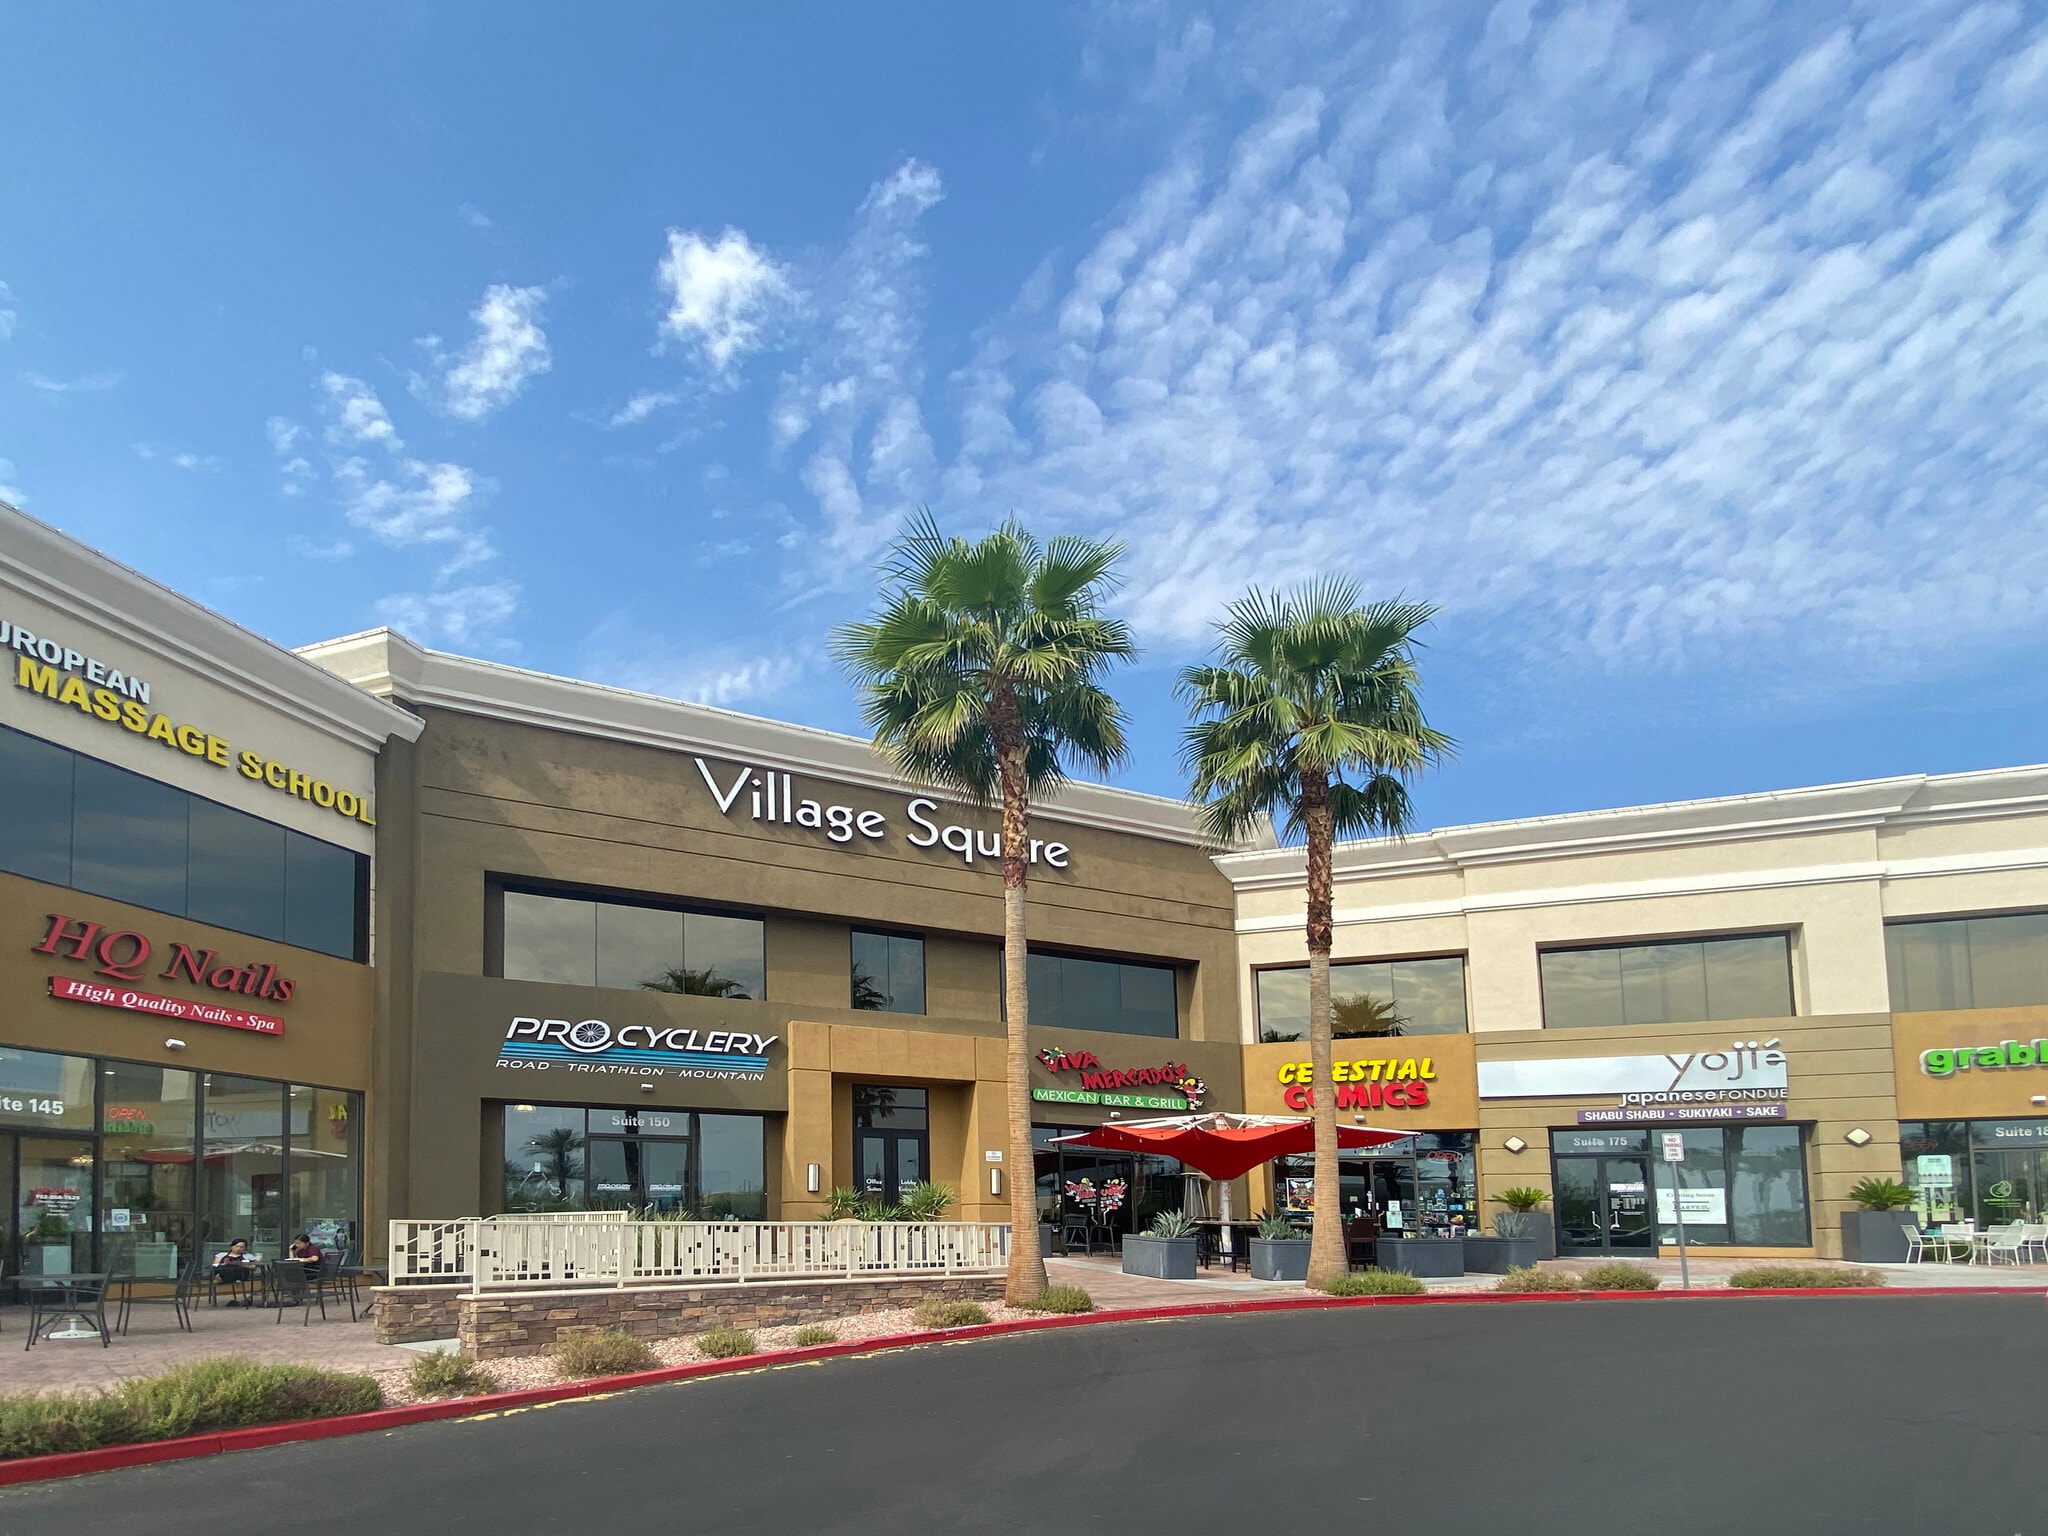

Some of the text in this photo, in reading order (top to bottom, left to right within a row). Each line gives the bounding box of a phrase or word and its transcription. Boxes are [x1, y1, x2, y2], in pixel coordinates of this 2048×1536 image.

[17, 655, 376, 826] MASSAGE SCHOOL
[694, 758, 1070, 868] Village Squre
[32, 913, 297, 1002] HQ Nails
[67, 981, 276, 1031] High Quality Nails Spa
[506, 1017, 778, 1054] PRO CYCLERY
[1036, 1050, 1100, 1074] VIVA
[1925, 1039, 2048, 1074] grab
[495, 1059, 765, 1081] ROAD TRIATHLON MOUNTAIN
[1080, 1060, 1188, 1091] MERCADO'S
[1278, 1057, 1436, 1084] CEESTIAL
[1036, 1089, 1184, 1110] MEXICAN BAR & GRILL
[1283, 1082, 1429, 1110] CMICS
[1719, 1088, 1788, 1100] FONDUE
[29, 1098, 65, 1115] 145
[108, 1106, 147, 1120] OPEN
[1584, 1106, 1779, 1121] SHABU SHABU SUKIYAKI SAKE
[611, 1115, 670, 1127] Suite 150
[1995, 1126, 2032, 1137] Suite
[1573, 1136, 1628, 1147] Suite 175
[1428, 1150, 1460, 1162] OPEN
